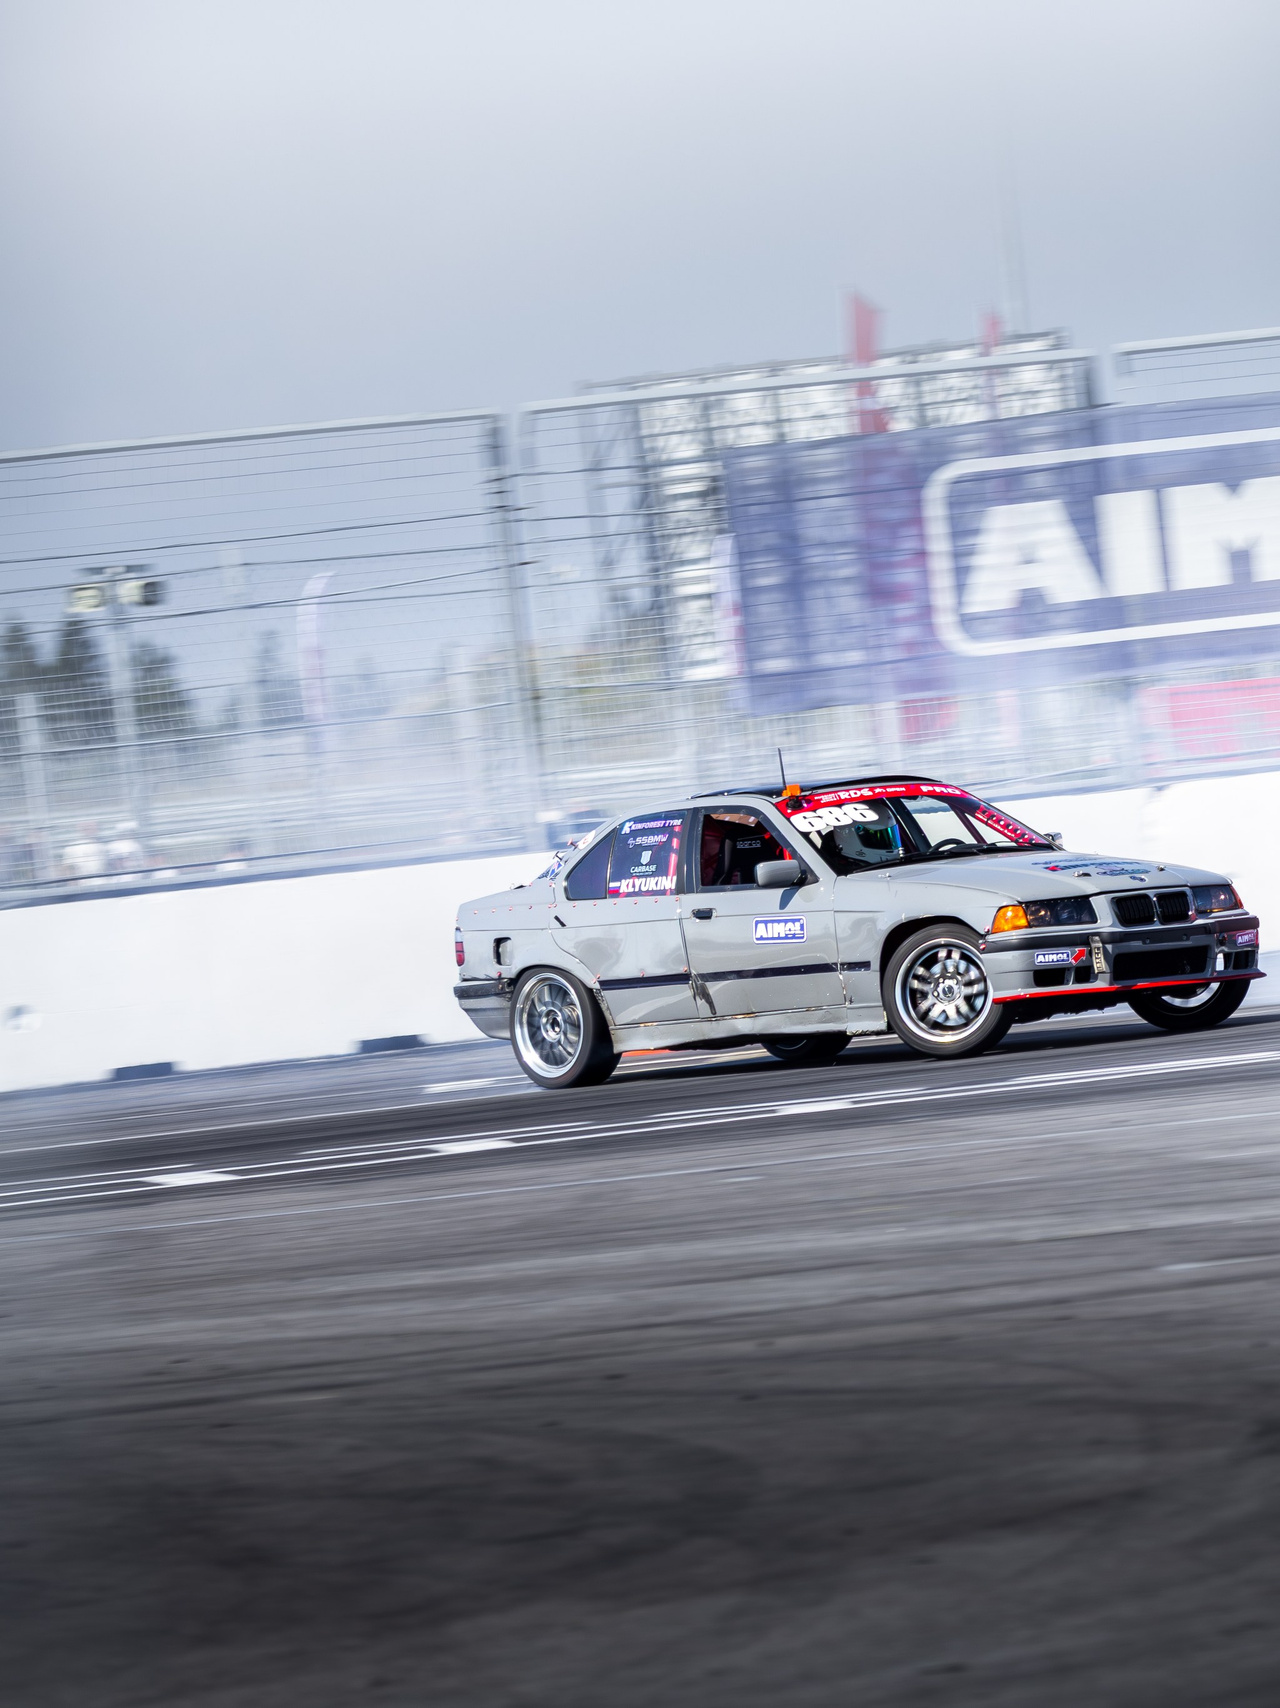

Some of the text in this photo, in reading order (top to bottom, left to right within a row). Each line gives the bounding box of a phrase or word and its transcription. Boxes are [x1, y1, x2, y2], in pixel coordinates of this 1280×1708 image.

[838, 788, 873, 799] RDS
[920, 786, 961, 794] PRO
[789, 803, 879, 833] 686
[630, 864, 657, 873] CARBASE
[755, 922, 804, 938] AIMOL
[1037, 951, 1069, 963] AIMOL
